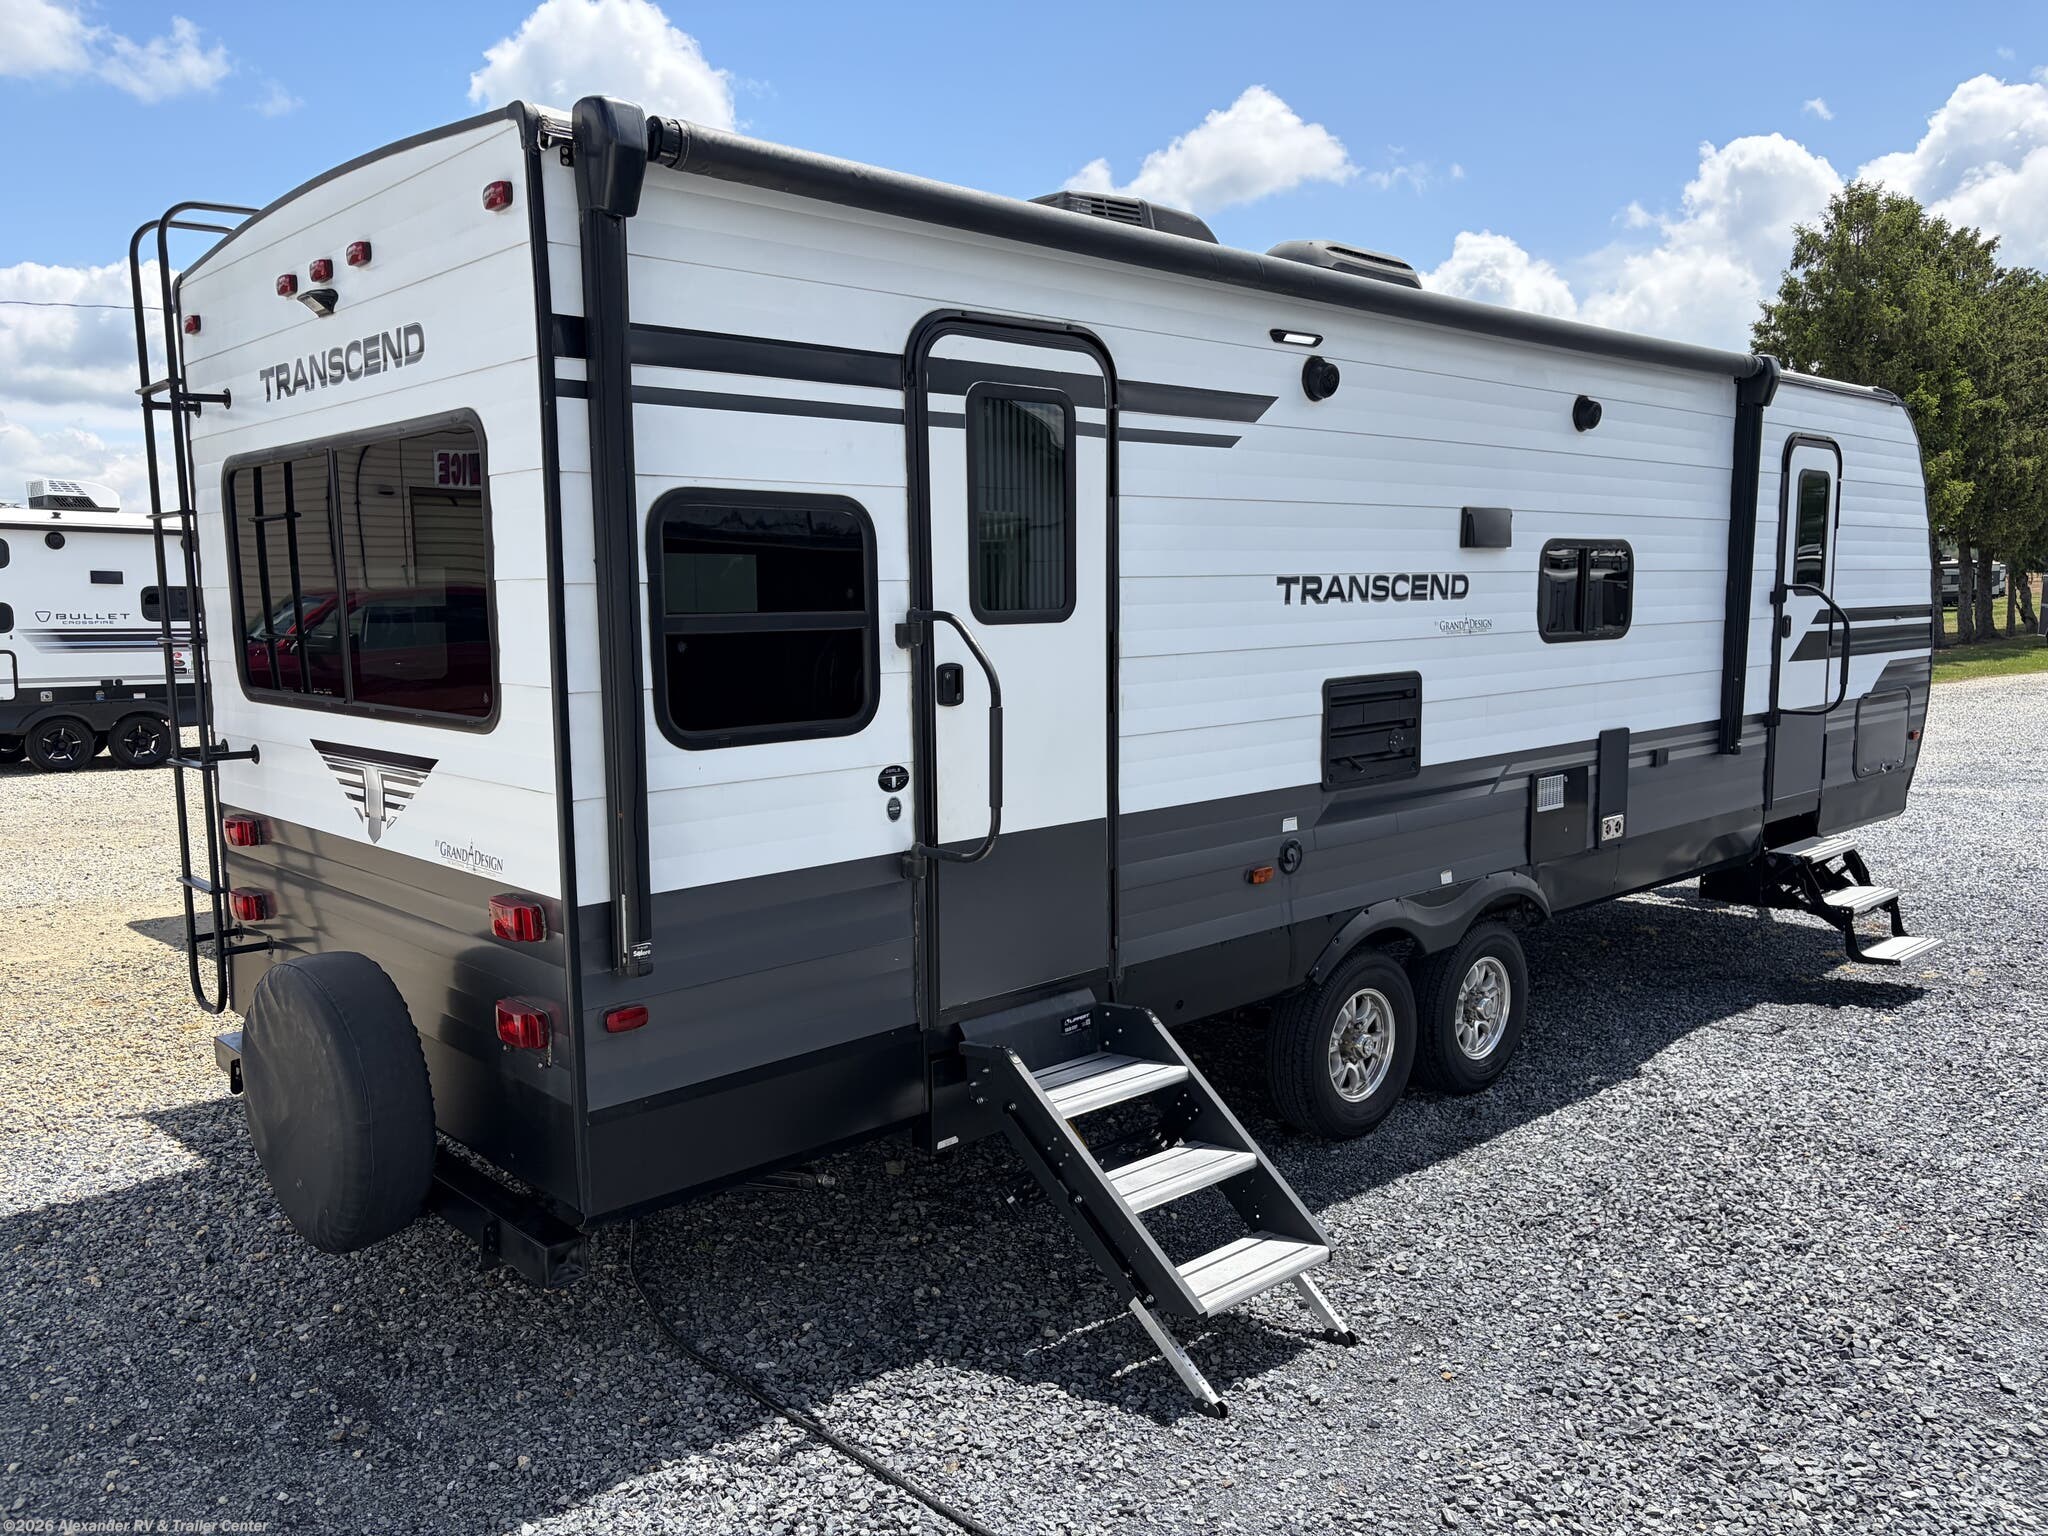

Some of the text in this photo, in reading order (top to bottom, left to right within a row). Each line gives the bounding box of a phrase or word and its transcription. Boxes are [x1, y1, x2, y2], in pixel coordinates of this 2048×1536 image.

[260, 322, 425, 403] TRANSCEND
[1276, 573, 1470, 606] TRANSCEND
[55, 612, 131, 620] BULLET
[1439, 619, 1464, 631] GRAND
[1469, 618, 1493, 630] DESIGN
[439, 841, 468, 862] GRAND
[474, 849, 504, 872] DESIGN
